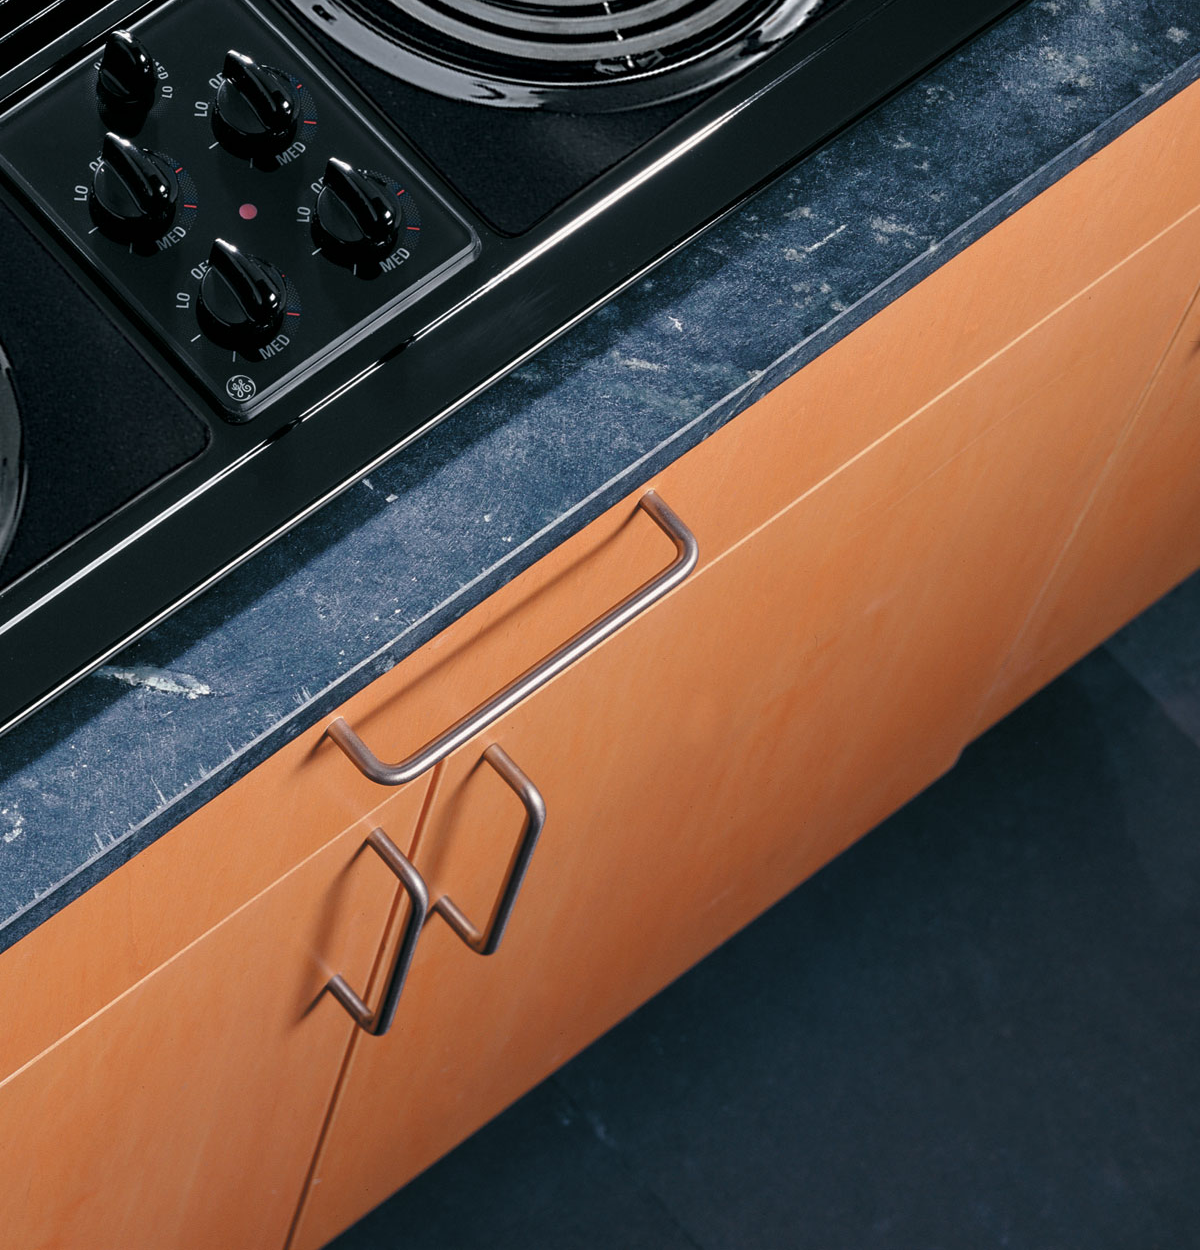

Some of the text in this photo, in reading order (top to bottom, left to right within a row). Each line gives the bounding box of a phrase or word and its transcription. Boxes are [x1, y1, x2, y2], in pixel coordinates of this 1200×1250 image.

[161, 85, 174, 99] LO
[194, 101, 209, 118] LO
[275, 141, 306, 166] MED
[73, 185, 89, 202] LO
[296, 206, 311, 223] LO
[155, 226, 187, 251] MED
[378, 247, 411, 273] MED
[175, 292, 191, 309] LO
[258, 334, 291, 360] MED
